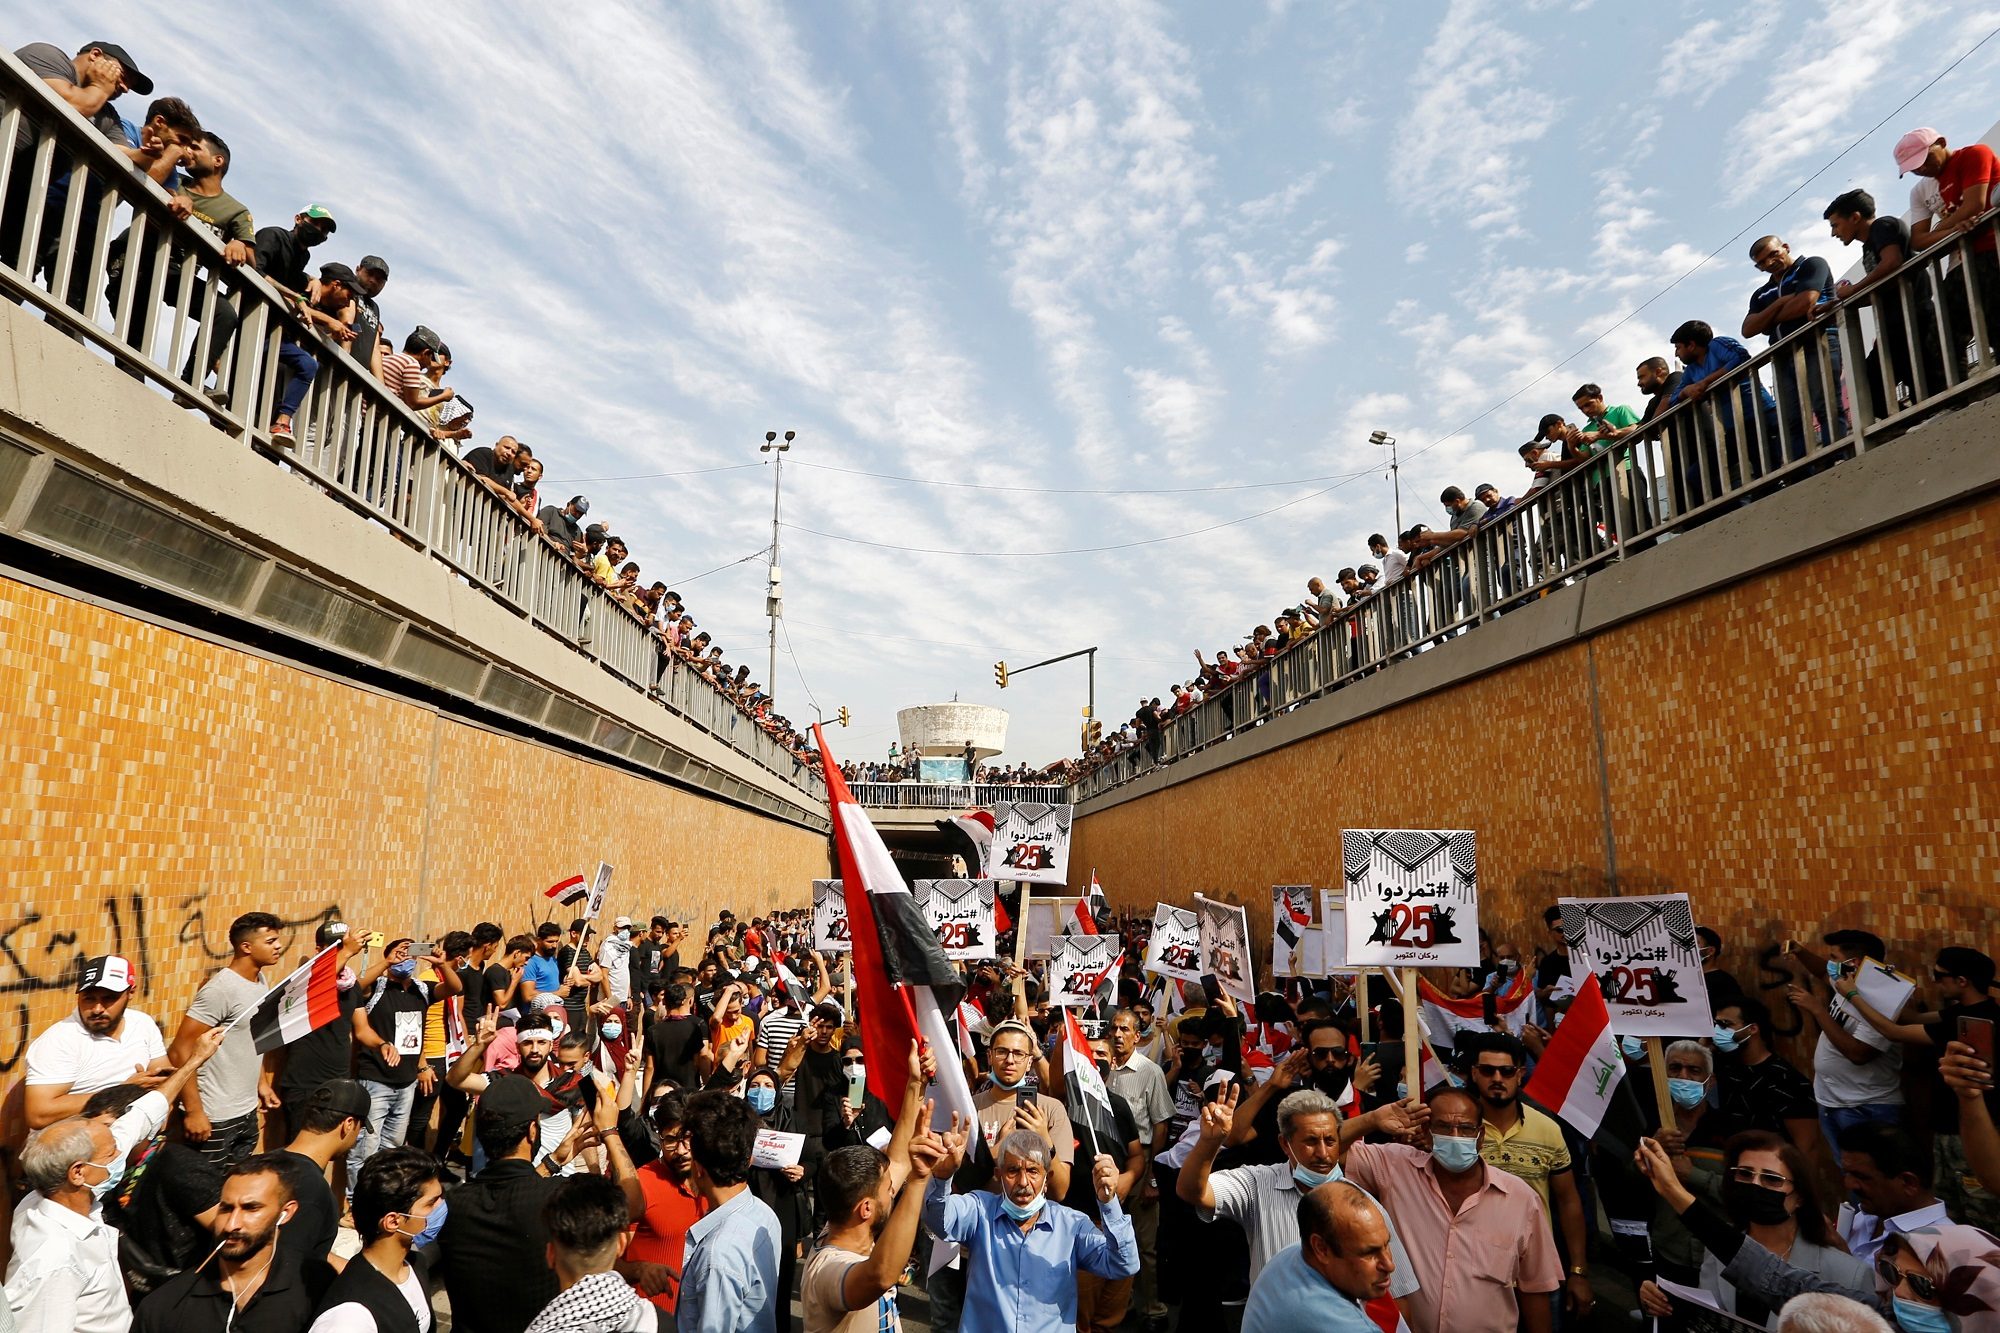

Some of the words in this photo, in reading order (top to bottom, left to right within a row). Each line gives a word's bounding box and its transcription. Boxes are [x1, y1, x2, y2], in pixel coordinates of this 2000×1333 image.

[1010, 831, 1053, 843] #تمردوا
[1014, 843, 1042, 870] 25
[1378, 882, 1449, 902] #تمردوا
[830, 907, 848, 918] ردوا
[934, 909, 977, 922] #تمردوا
[836, 918, 852, 941] 2
[1391, 903, 1436, 949] 25
[941, 922, 969, 949] 25
[1168, 933, 1200, 948] #تمردوا
[1167, 944, 1192, 970] 25
[1214, 946, 1233, 980] 25
[1394, 952, 1416, 960] اكتوبر
[1418, 952, 1439, 960] بركان
[1596, 947, 1668, 965] #تمردوا
[1067, 961, 1104, 971] #تمردوا
[1072, 972, 1096, 996] 25
[1612, 965, 1660, 1007] 25
[1621, 1008, 1643, 1016] اكتوبر
[1644, 1009, 1665, 1017] بركان
